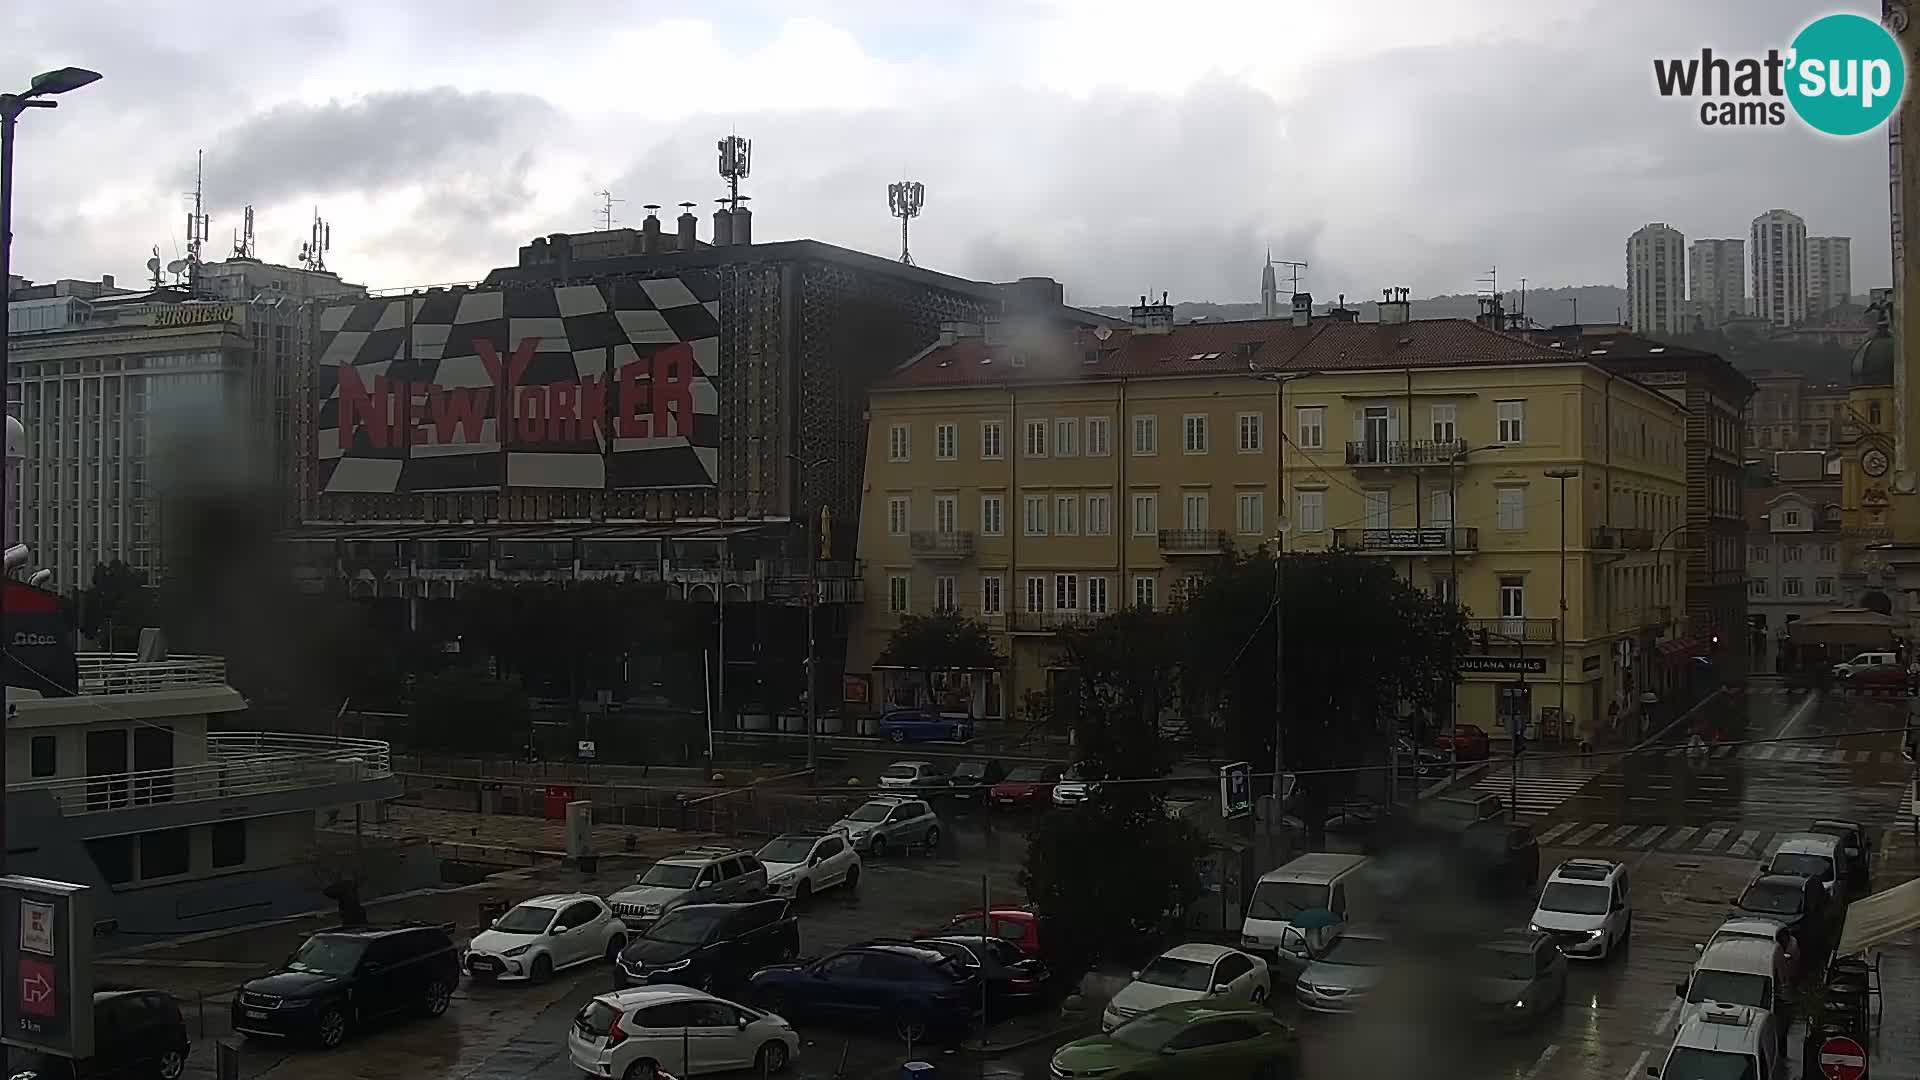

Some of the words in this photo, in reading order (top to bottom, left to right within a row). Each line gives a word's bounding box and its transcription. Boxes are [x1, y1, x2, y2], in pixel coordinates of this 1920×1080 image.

[1459, 660, 1505, 670] JULIANA
[1508, 661, 1541, 670] NAILS
[1231, 770, 1244, 794] P
